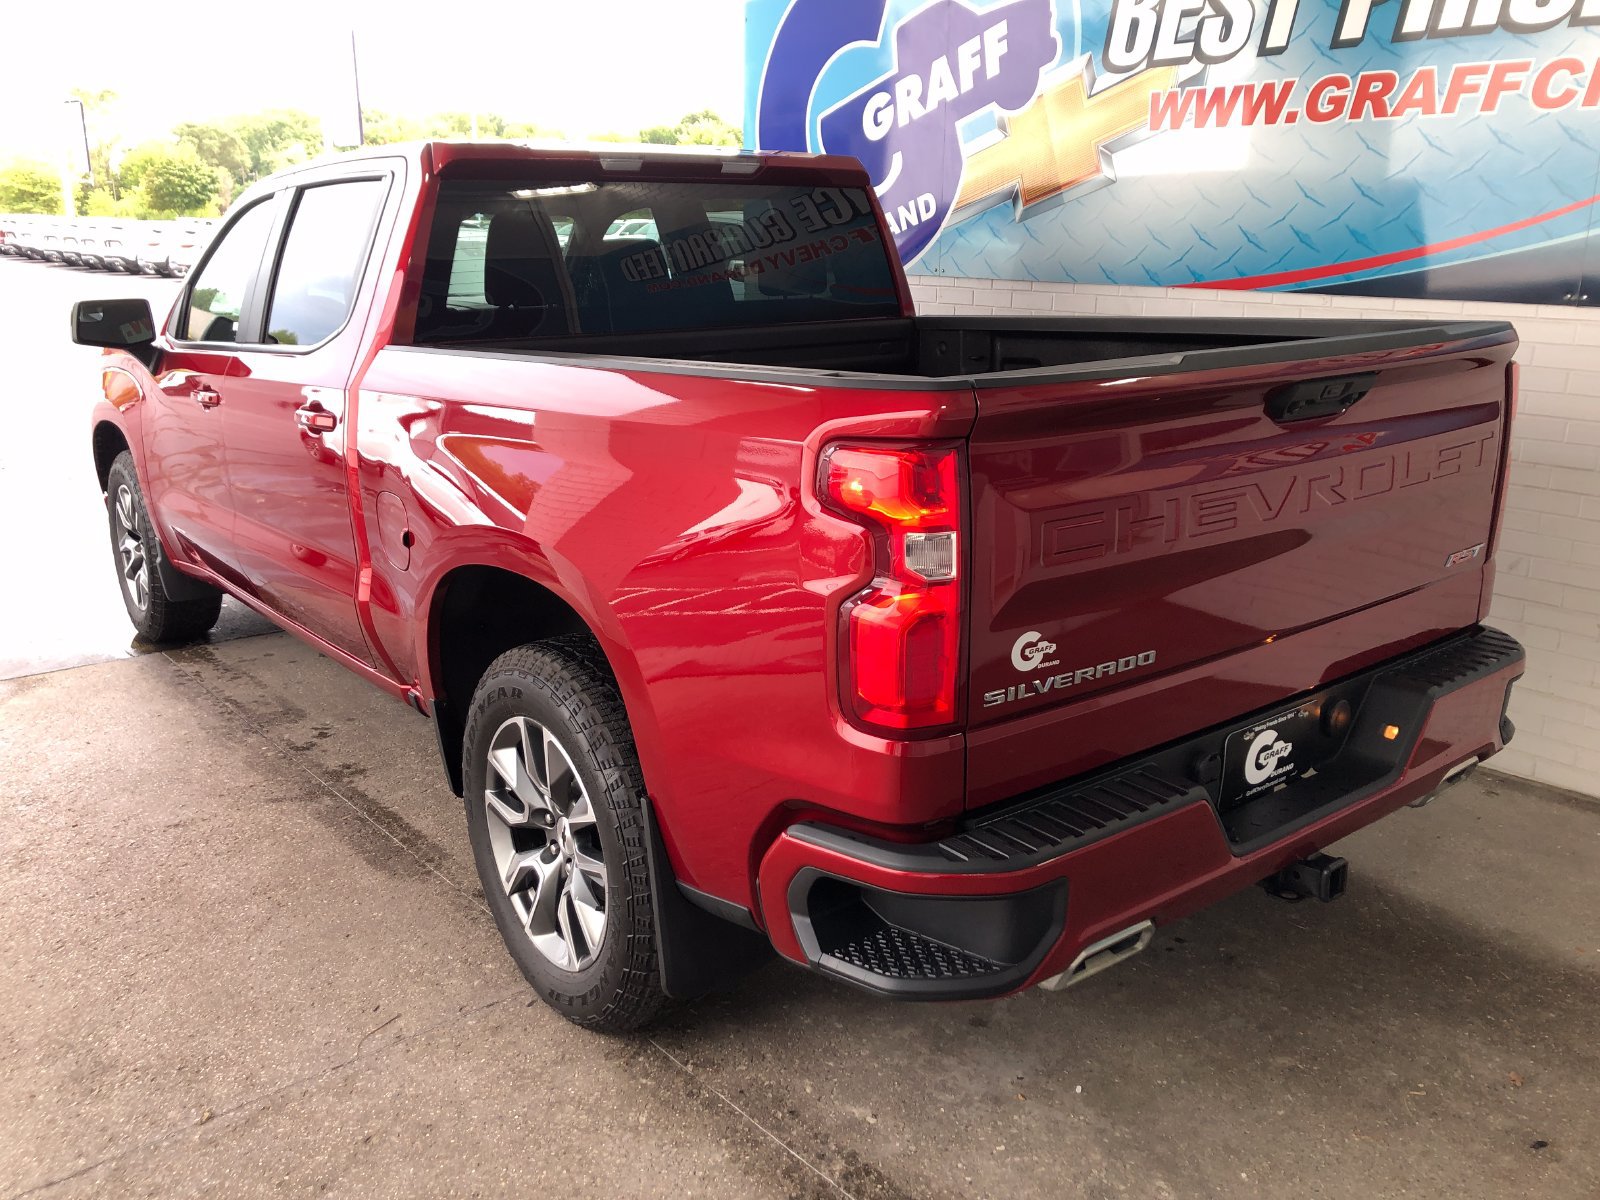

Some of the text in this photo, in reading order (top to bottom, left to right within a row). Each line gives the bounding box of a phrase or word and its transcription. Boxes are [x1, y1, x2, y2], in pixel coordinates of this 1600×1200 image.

[863, 19, 1008, 141] GRAFF
[1040, 430, 1495, 568] CHEVROLET
[1443, 542, 1485, 568] RST
[1029, 644, 1053, 655] GRAFF
[1037, 659, 1060, 669] DURAND
[983, 649, 1157, 708] SILVERADO
[1264, 744, 1289, 761] GRAFF
[1270, 762, 1295, 778] DURAND
